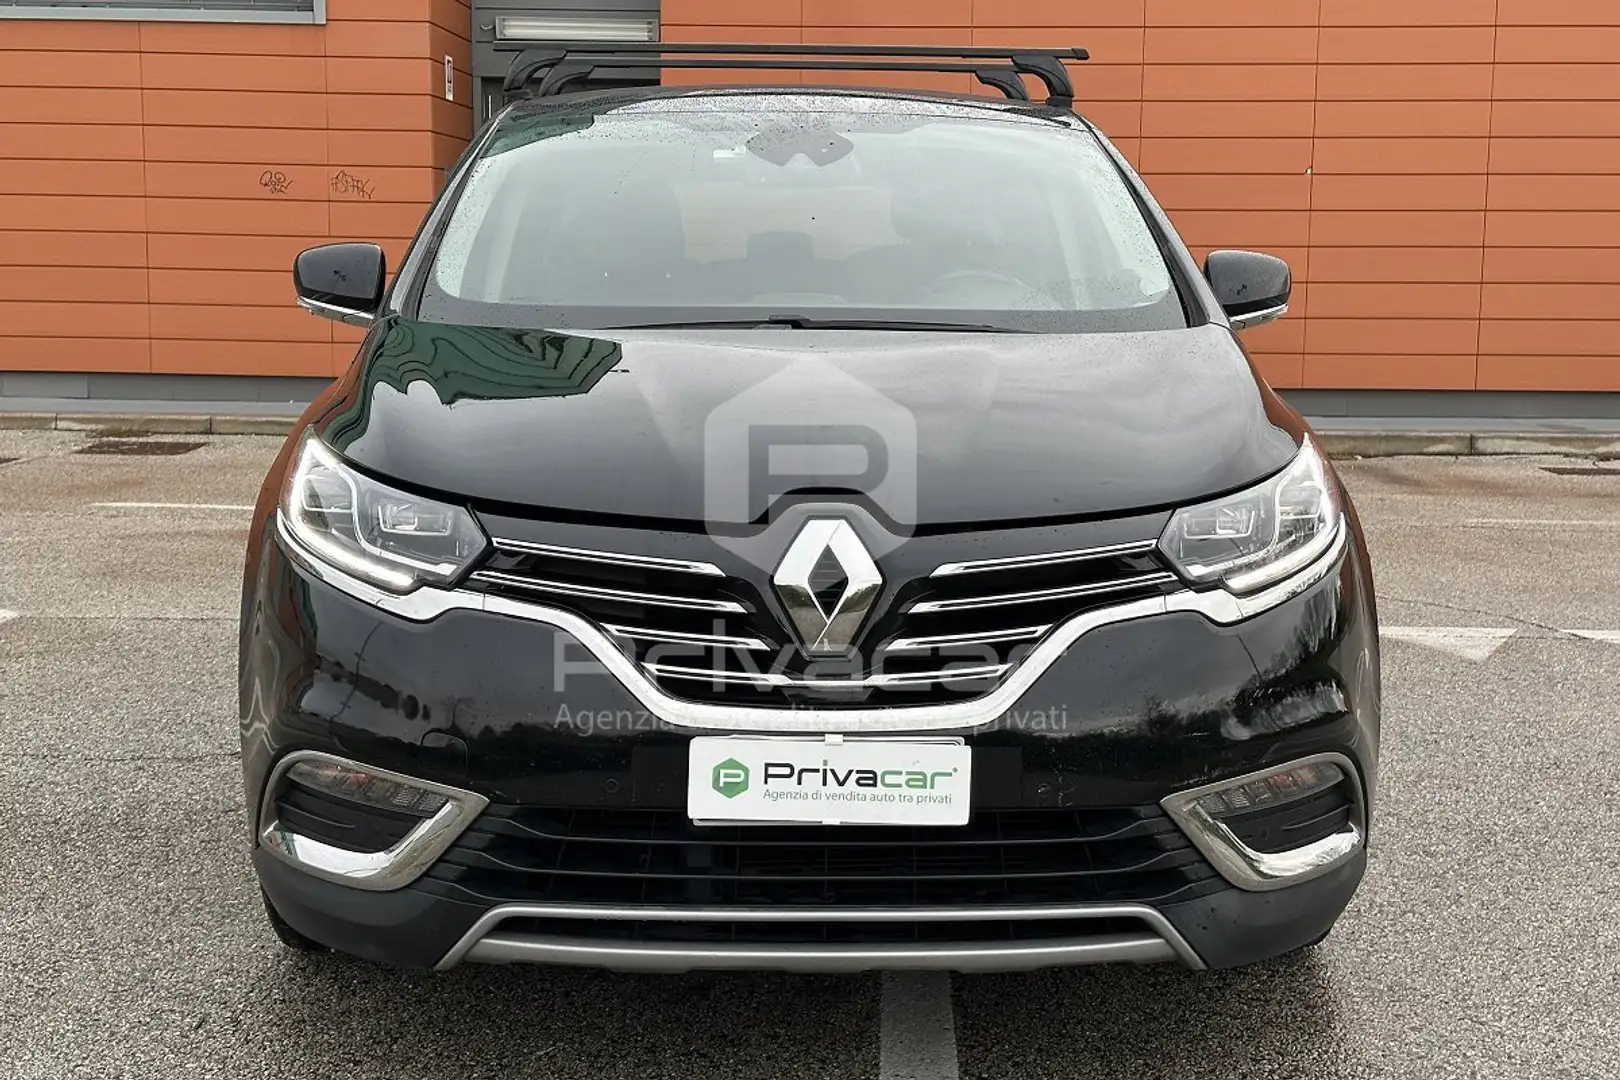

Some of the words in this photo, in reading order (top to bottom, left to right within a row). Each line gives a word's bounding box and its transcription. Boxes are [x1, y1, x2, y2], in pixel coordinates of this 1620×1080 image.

[763, 789, 808, 802] Agenzia
[811, 789, 822, 801] di
[825, 791, 867, 802] vendita
[869, 793, 896, 802] auto
[898, 793, 914, 803] tra
[916, 793, 952, 805] privati
